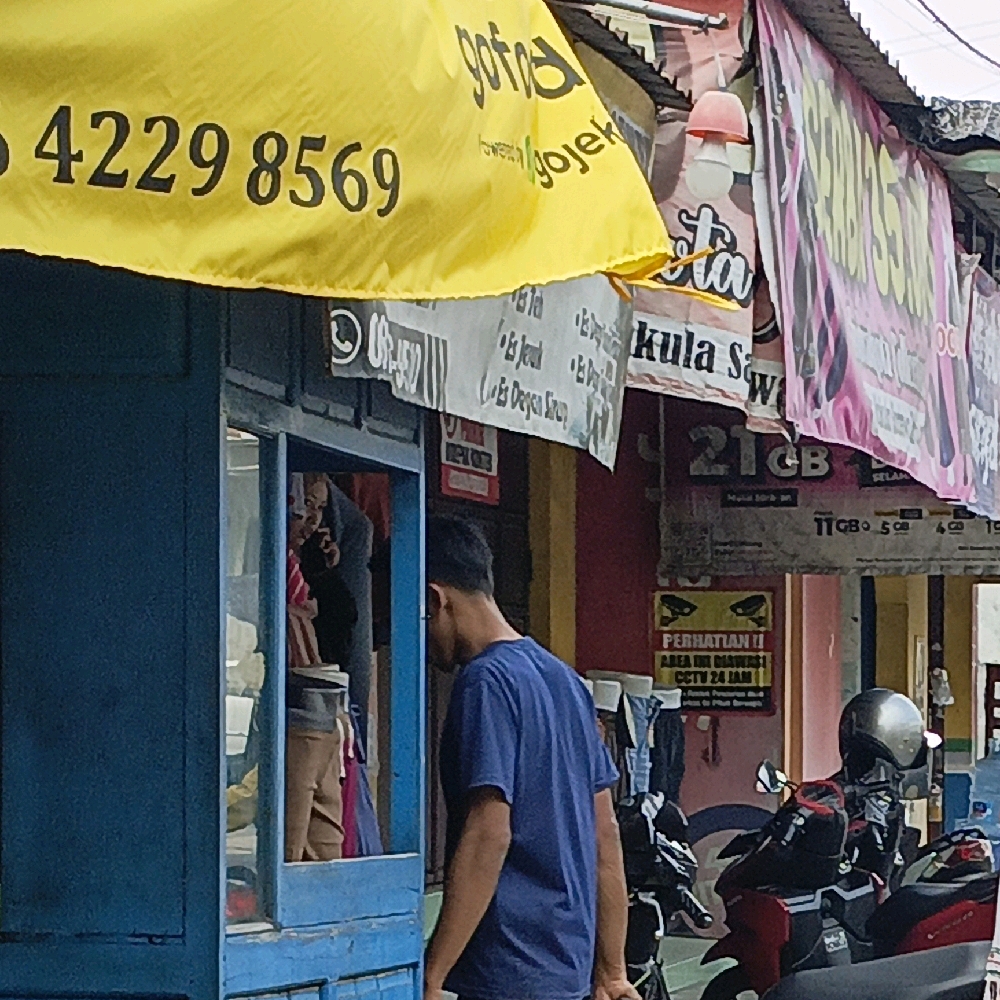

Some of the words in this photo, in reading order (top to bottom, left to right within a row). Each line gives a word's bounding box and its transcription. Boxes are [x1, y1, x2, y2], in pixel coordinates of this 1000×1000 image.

[35, 105, 229, 197] 4229
[245, 131, 401, 217] 8569
[533, 115, 629, 190] gojek
[632, 320, 716, 374] kula
[662, 633, 749, 649] PERHATIAN
[675, 670, 708, 685] CCTV
[710, 670, 726, 684] 24
[728, 670, 752, 684] JAM
